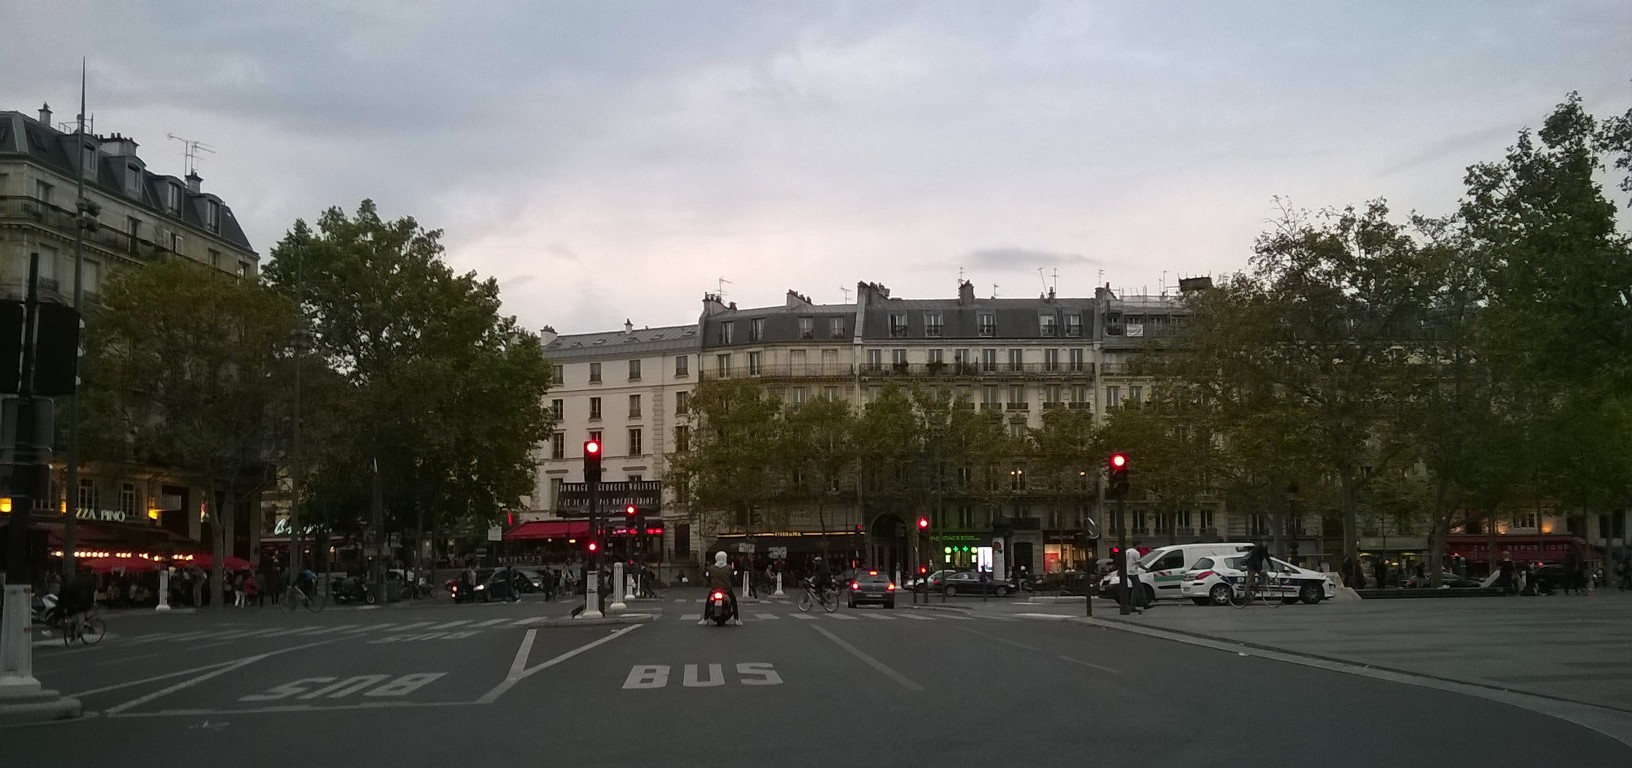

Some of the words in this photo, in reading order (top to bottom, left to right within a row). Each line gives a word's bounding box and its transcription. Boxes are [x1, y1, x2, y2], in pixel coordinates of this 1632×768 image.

[75, 508, 97, 520] ZZA
[100, 509, 126, 522] PINO
[237, 672, 449, 702] BUS
[621, 662, 784, 690] BUS
